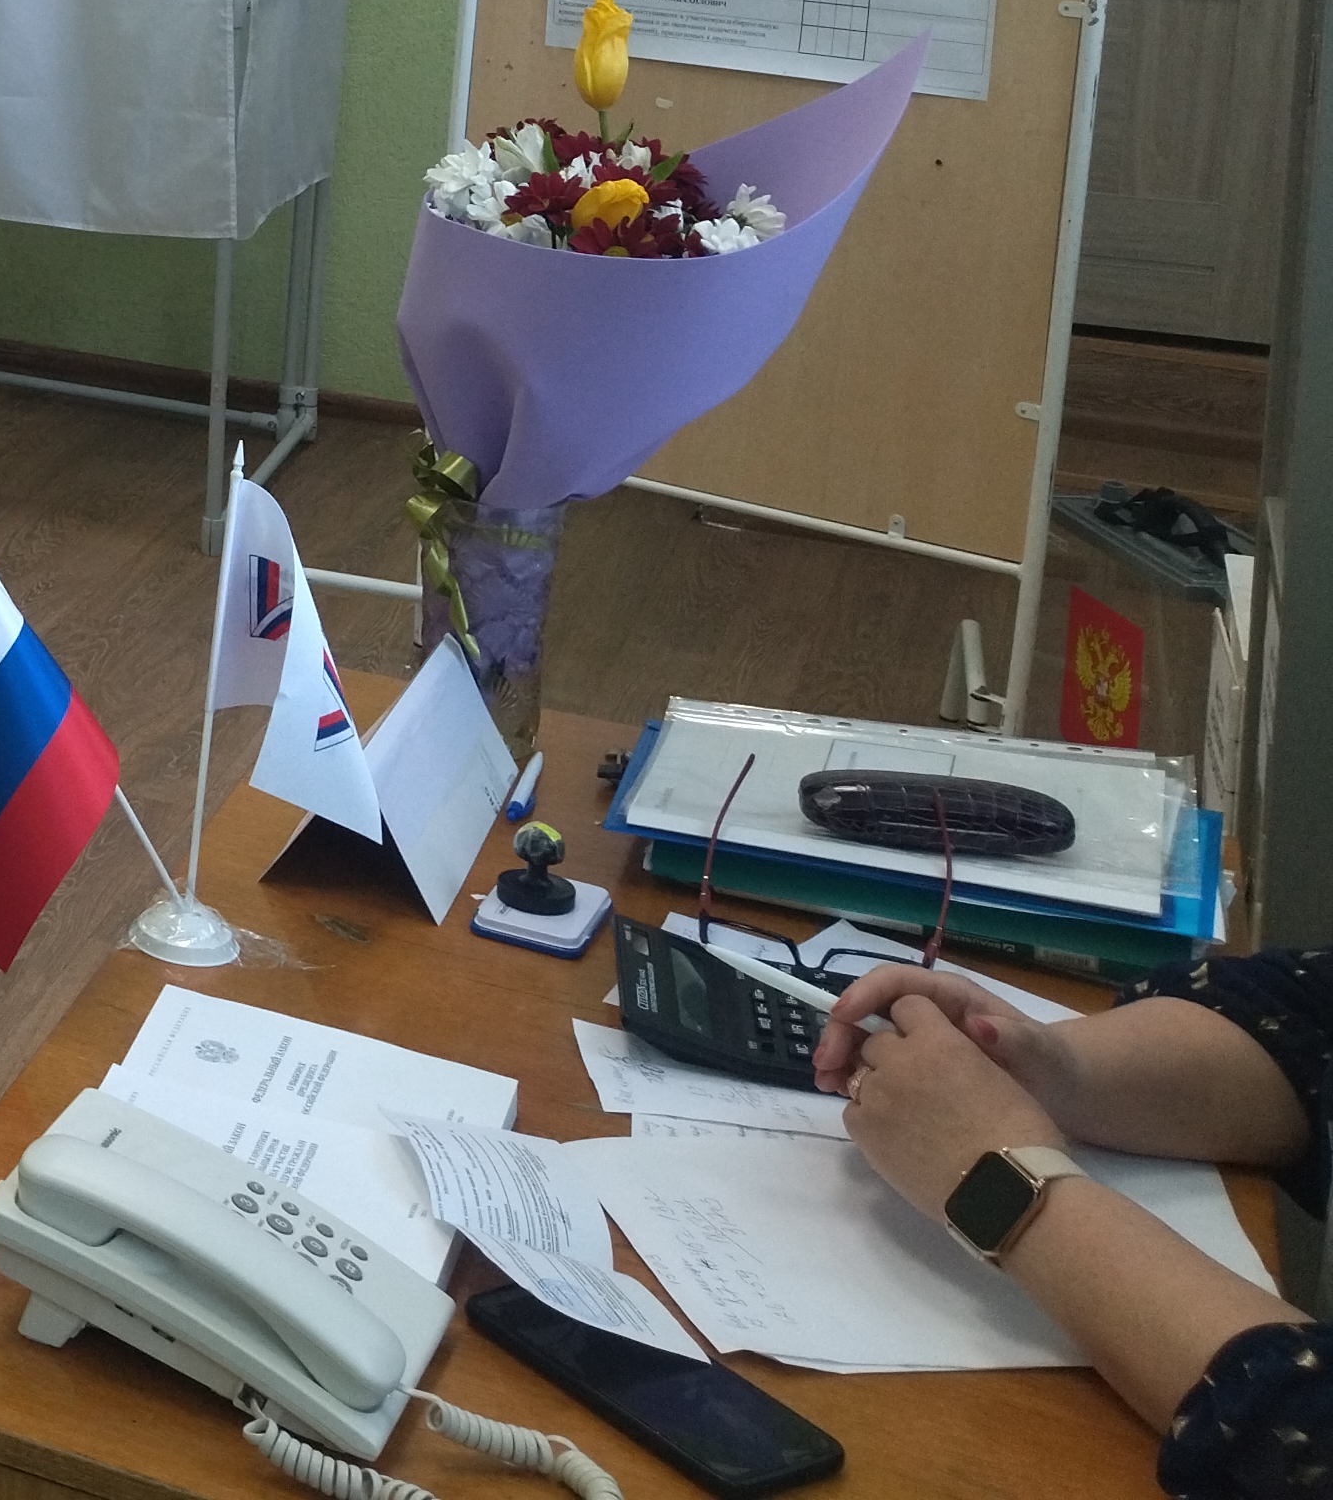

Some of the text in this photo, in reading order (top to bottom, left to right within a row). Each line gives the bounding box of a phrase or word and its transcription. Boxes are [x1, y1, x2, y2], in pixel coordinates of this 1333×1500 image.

[252, 1036, 293, 1104] ФЕДЕРАЛЬНЫЙ ЗАКОН
[291, 1062, 306, 1086] ВЫБОРАХ
[297, 1064, 319, 1097] ПРЕЗИДЕНТА
[301, 1049, 338, 1115] ОССИЙСКОЙ ФЕДЕРАЦИИ
